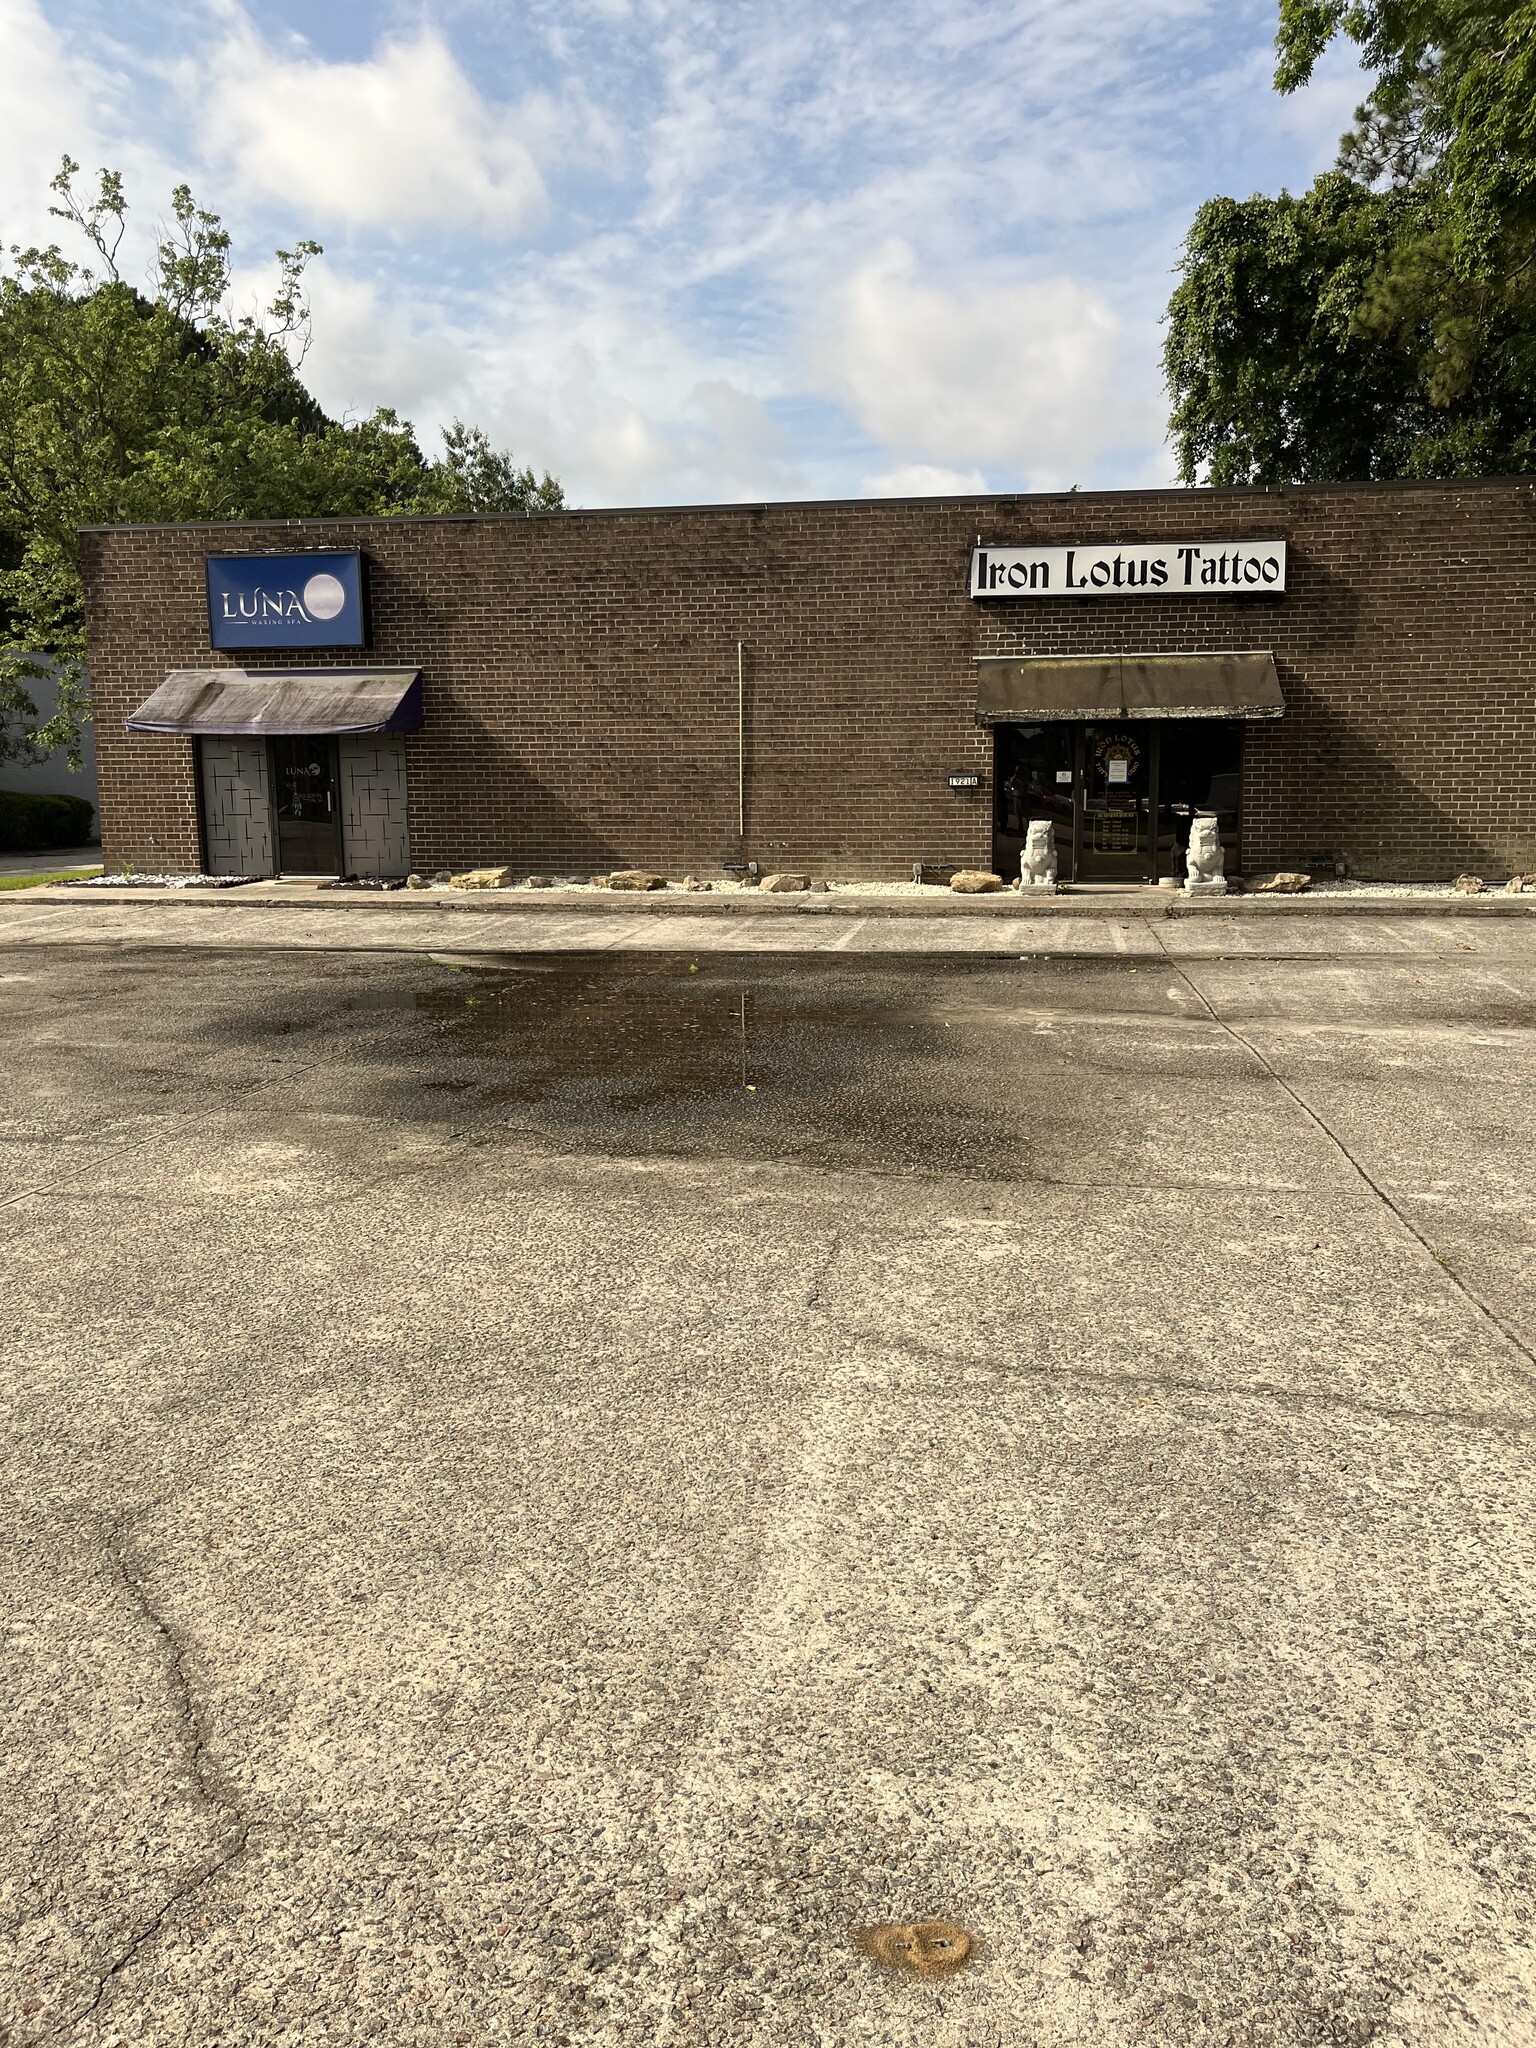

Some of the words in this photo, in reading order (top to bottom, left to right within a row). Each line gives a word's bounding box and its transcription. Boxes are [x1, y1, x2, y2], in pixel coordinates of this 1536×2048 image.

[977, 552, 1049, 589] Iron
[1065, 550, 1168, 588] Lotus
[1177, 548, 1280, 586] Tattoo
[221, 586, 313, 623] LUNA
[1115, 734, 1140, 756] LOTUS
[285, 767, 311, 777] LUNA
